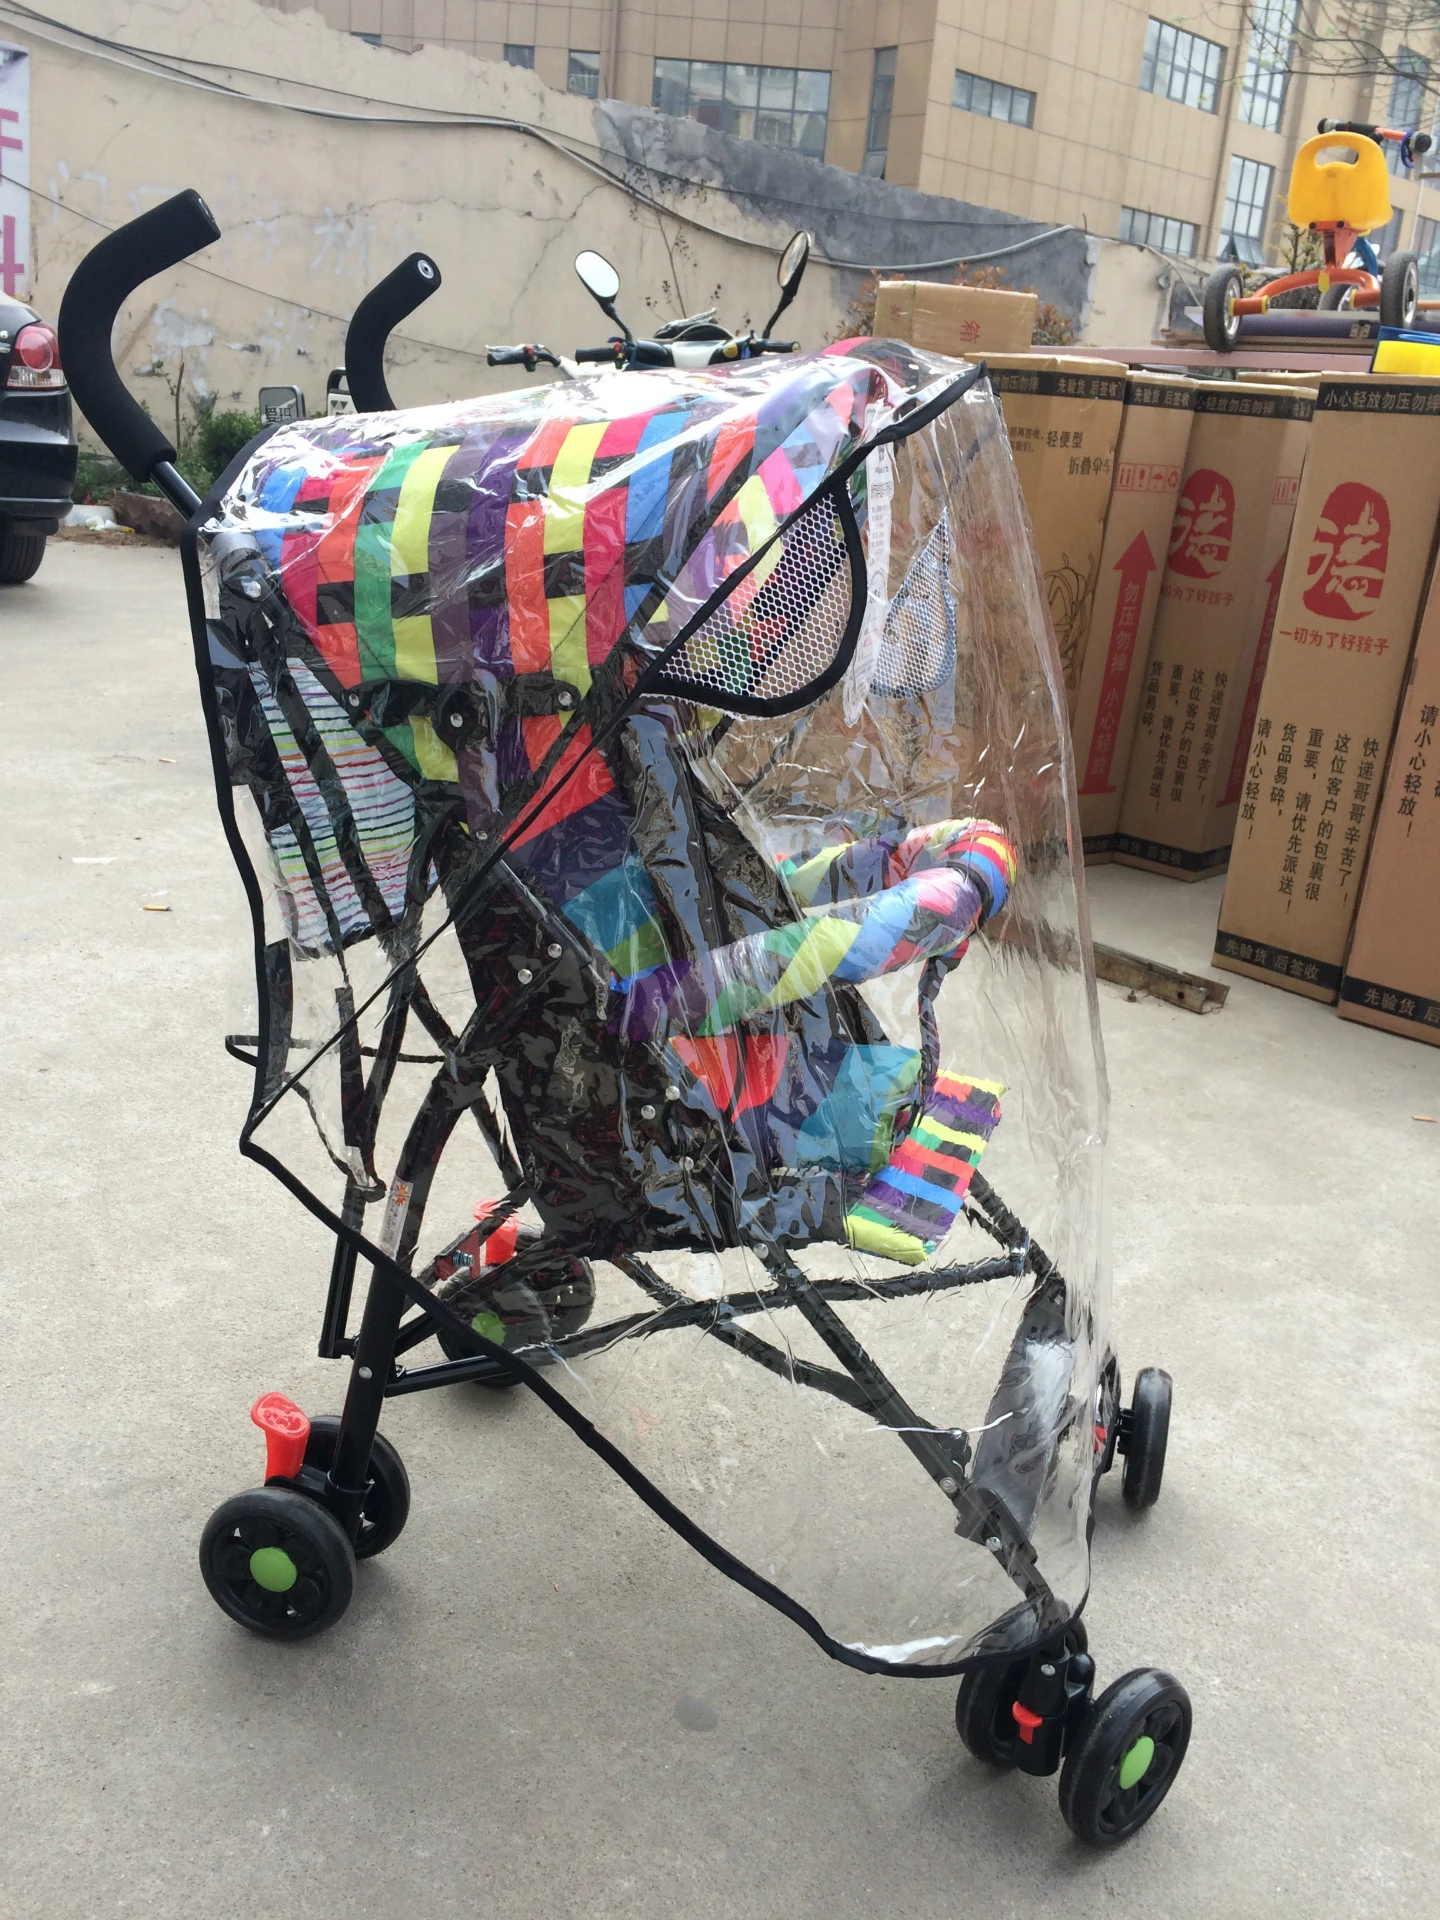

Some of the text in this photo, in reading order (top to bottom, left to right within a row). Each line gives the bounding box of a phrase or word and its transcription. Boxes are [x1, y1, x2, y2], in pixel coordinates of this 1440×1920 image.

[1057, 376, 1086, 395] 先验货
[1090, 378, 1118, 397] 后签收
[1133, 388, 1191, 407] 先验货 后签收
[1046, 429, 1084, 449] 轻便型
[1067, 456, 1112, 475] 折叠伞车
[1280, 627, 1389, 656] 一切为了好孩子
[1091, 581, 1140, 775] 勿压勿摔 小心轻放
[1170, 668, 1205, 802] 这位客户的包裹很
[1241, 718, 1272, 840] 请小心轻放！
[1398, 704, 1440, 838] 请小心轻放！
[1305, 734, 1351, 901] 这位客户的包裹很
[1338, 737, 1379, 908] 快递哥哥辛苦了！
[1226, 938, 1320, 982] 先验货 后签收
[1364, 988, 1416, 1017] 先验货
